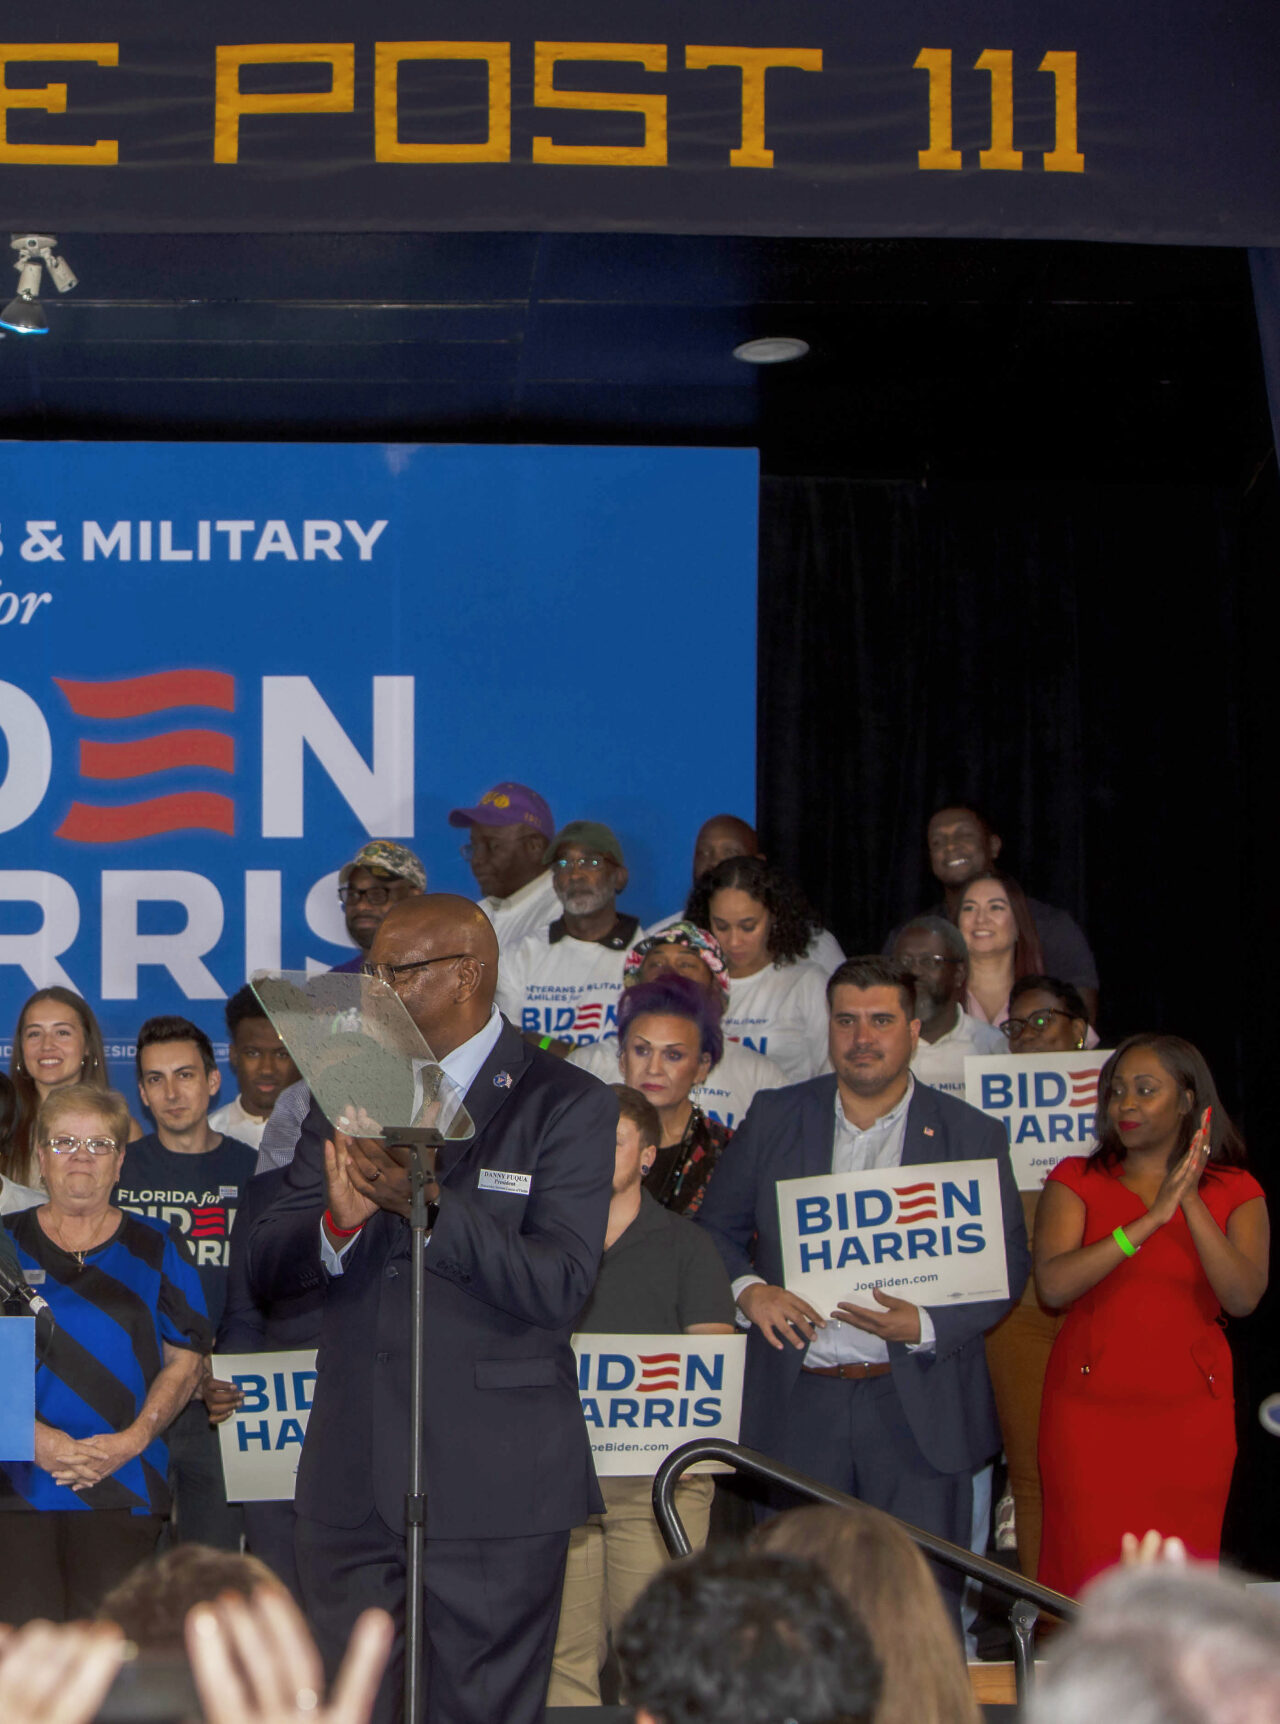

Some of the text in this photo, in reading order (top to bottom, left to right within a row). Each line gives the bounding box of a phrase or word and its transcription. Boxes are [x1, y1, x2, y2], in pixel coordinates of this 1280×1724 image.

[215, 41, 823, 169] POST
[914, 48, 1086, 173] 111
[19, 520, 66, 563] &
[83, 520, 389, 562] MILITARY
[981, 1069, 1101, 1110] BIDE
[117, 1188, 198, 1203] FLORIDA
[198, 1191, 225, 1207] for
[484, 1171, 528, 1183] DANNY FUQUA
[795, 1179, 982, 1237] BIDEN
[799, 1222, 987, 1274] HARRIS
[853, 1271, 939, 1292] JoeBiden.com
[579, 1352, 725, 1393] IDEN
[581, 1396, 723, 1428] ARRIS
[591, 1442, 669, 1452] oeBiden.com
